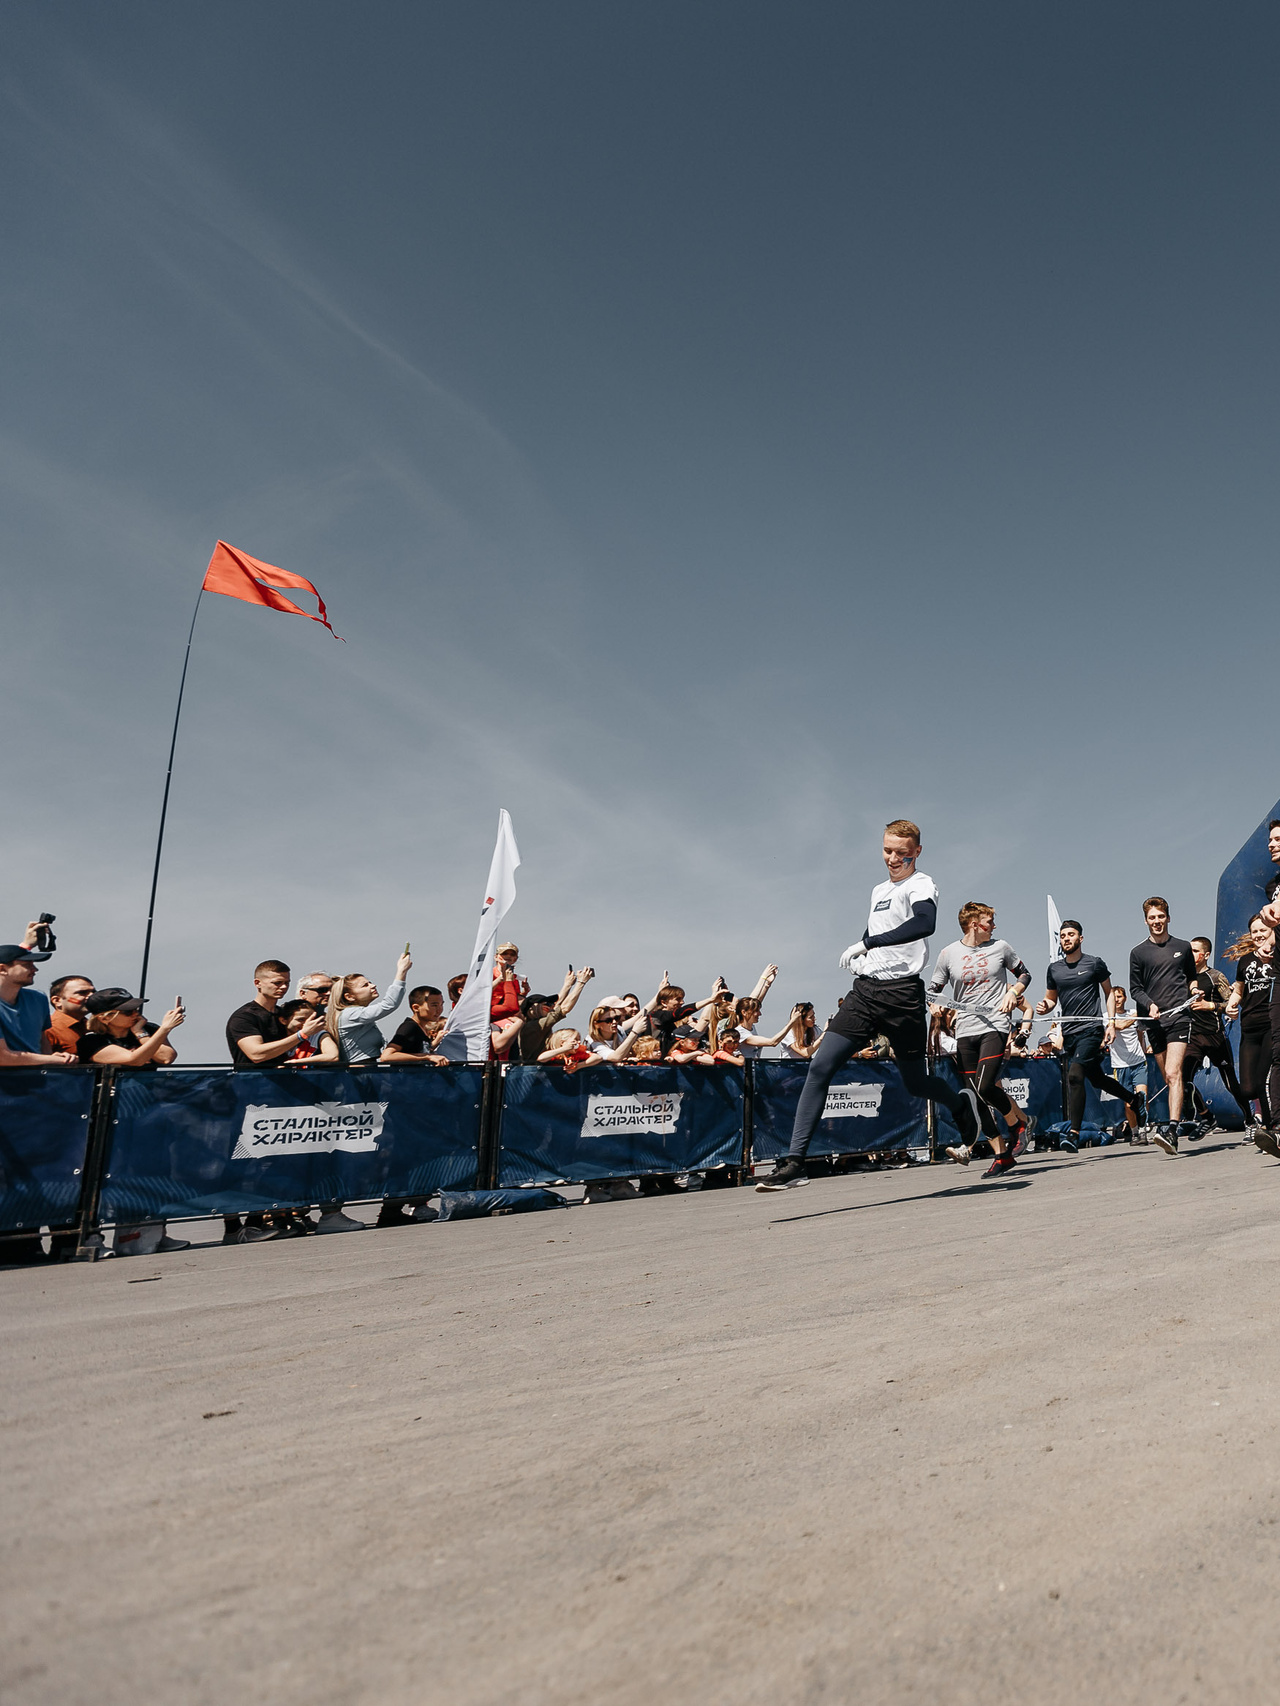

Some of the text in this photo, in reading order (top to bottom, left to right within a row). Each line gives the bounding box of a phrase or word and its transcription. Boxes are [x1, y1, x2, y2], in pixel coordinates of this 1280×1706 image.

[828, 1092, 852, 1101] TEEL
[593, 1100, 674, 1116] СТАЛЬНОЙ
[826, 1101, 878, 1110] HARACTER
[253, 1110, 374, 1131] СТАЛЬНОЙ
[593, 1114, 673, 1127] ХАРАКТЕР
[252, 1128, 373, 1146] ХАРАКТЕР
